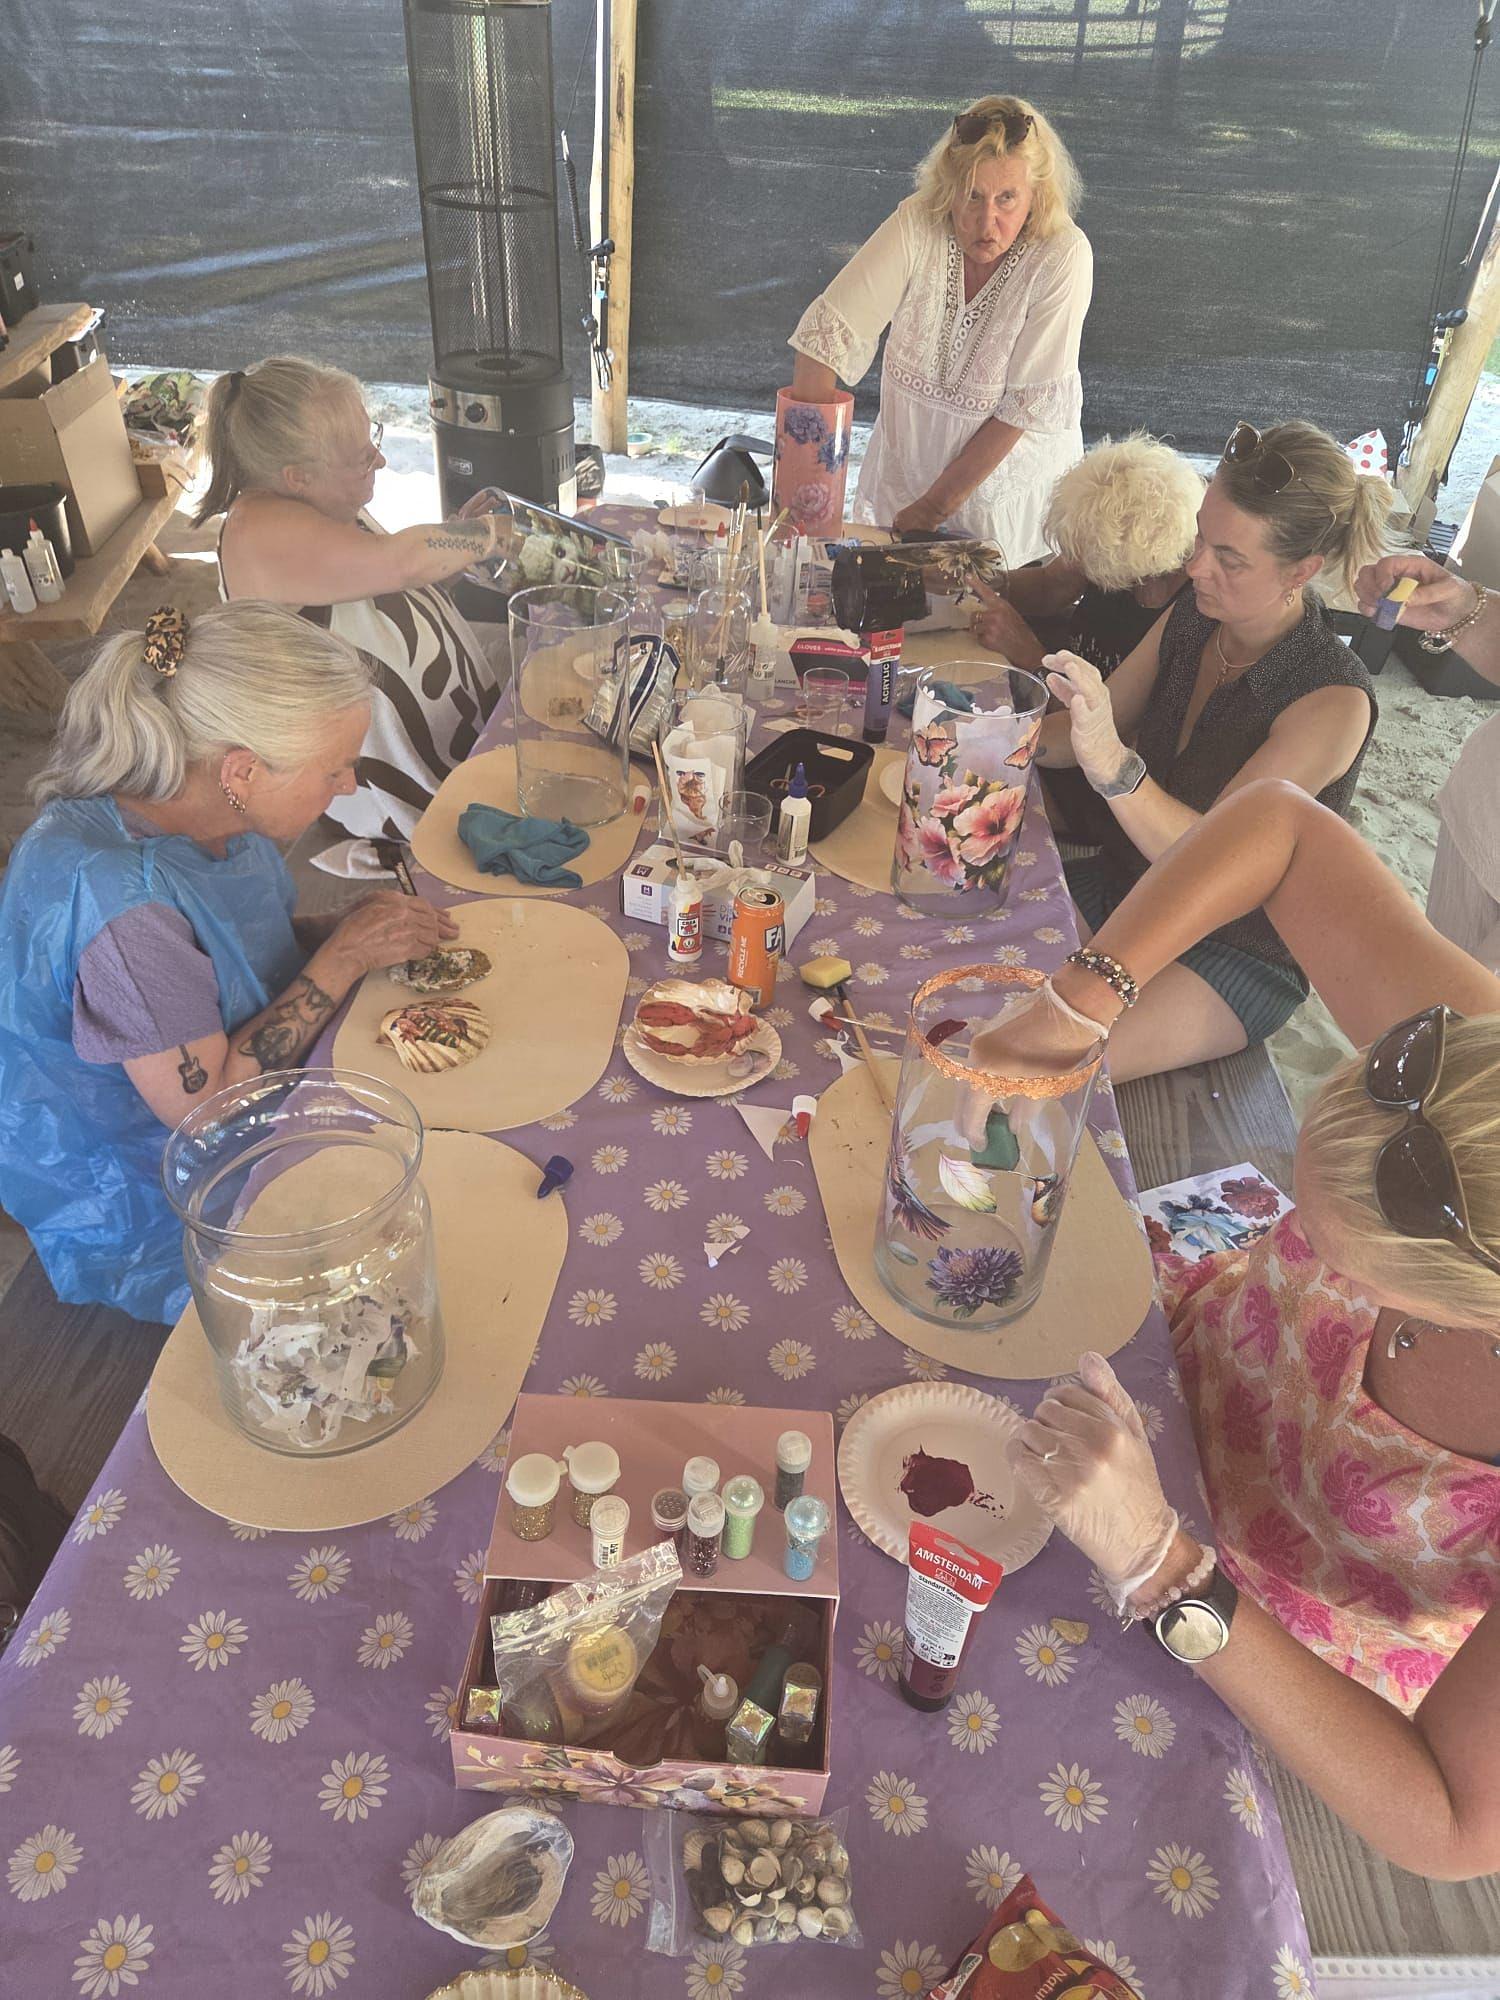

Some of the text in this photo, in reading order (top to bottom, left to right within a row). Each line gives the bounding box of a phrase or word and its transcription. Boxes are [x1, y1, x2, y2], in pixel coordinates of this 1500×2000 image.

[797, 643, 821, 651] GLOVES
[882, 662, 891, 703] ACRYLIC
[736, 947, 747, 979] RECYCLE
[915, 1547, 984, 1590] AMSTERDAM
[918, 1574, 946, 1593] Standard
[945, 1588, 964, 1605] Series
[1035, 1967, 1068, 2000] Natur
